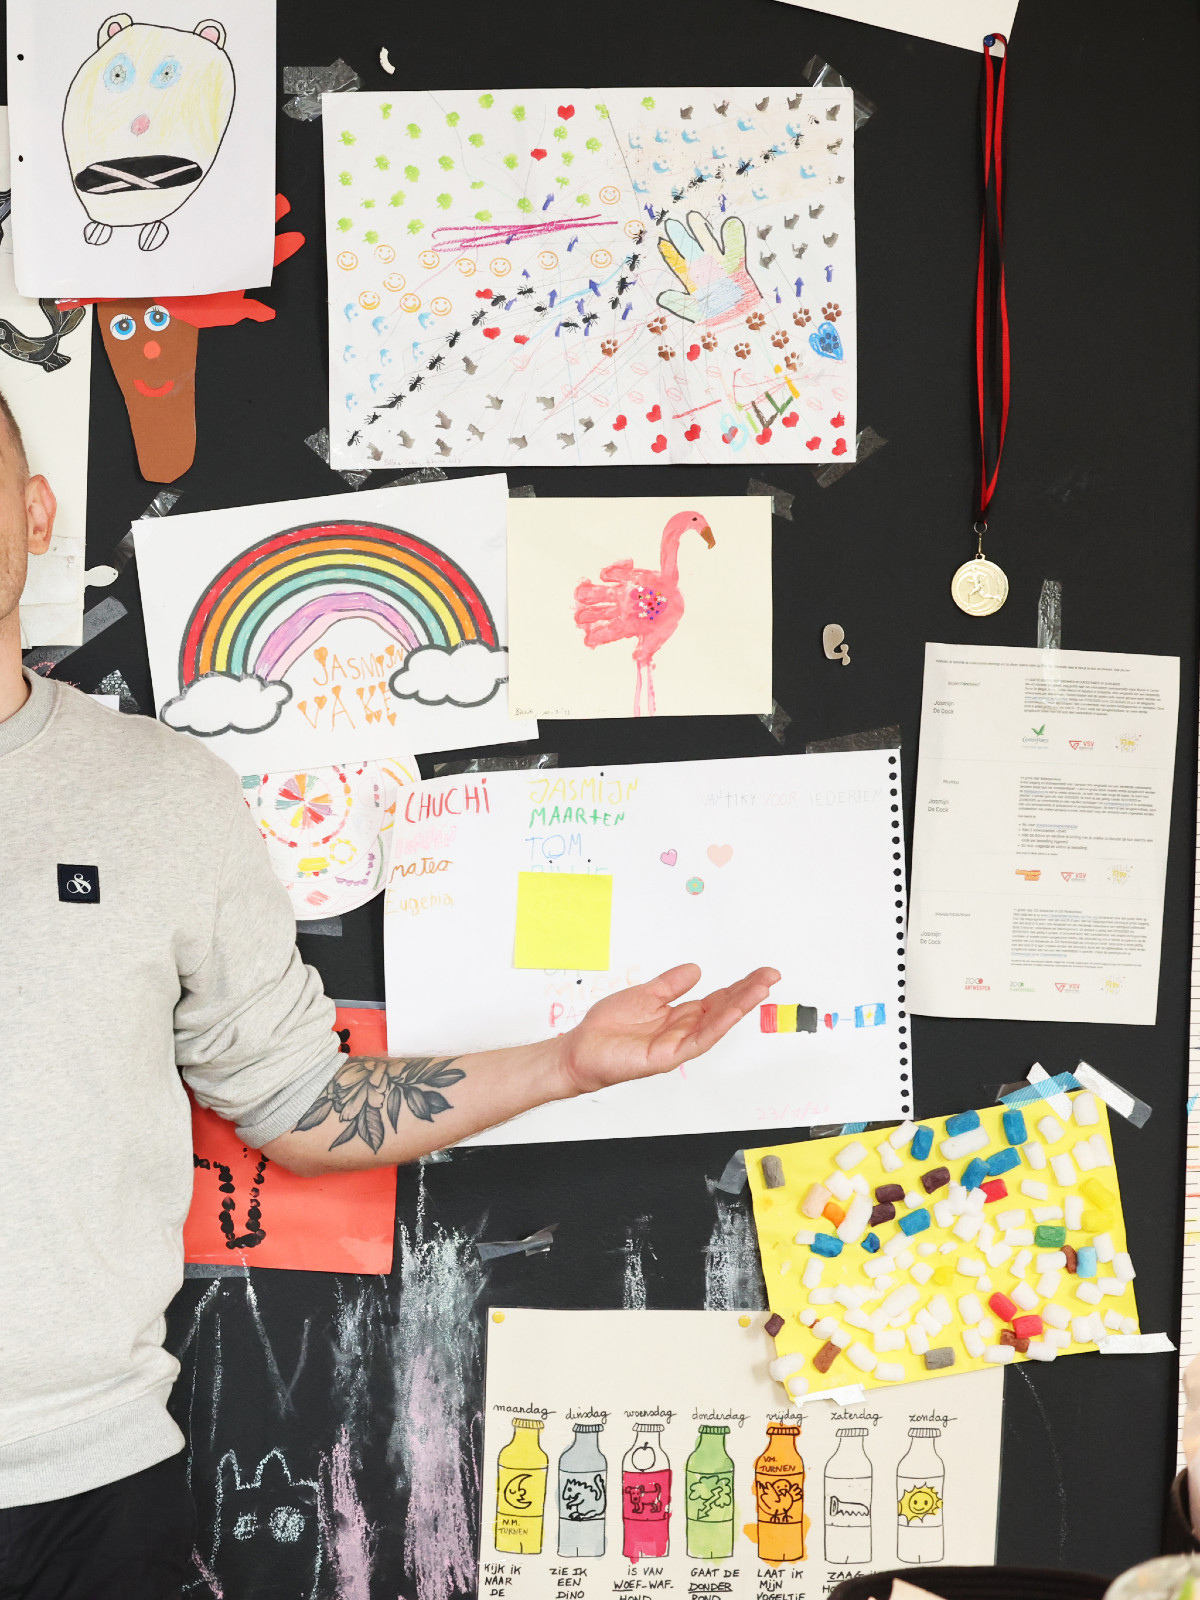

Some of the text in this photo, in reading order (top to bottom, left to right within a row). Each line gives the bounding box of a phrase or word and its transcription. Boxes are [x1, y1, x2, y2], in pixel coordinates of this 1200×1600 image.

[313, 645, 404, 687] JASMIJN
[296, 681, 398, 733] VAKE
[526, 775, 640, 806] JASMIJN
[524, 833, 584, 861] TOM
[493, 1403, 557, 1421] maandag
[565, 1406, 613, 1425] dinsdag
[624, 1405, 677, 1425] woensdag
[692, 1406, 751, 1428] donderdag
[766, 1409, 810, 1428] vrijdag
[831, 1408, 884, 1427] zaterdag
[908, 1408, 959, 1428] zondag
[759, 1464, 797, 1473] TURNEN
[571, 1567, 588, 1577] IK
[643, 1567, 664, 1576] VAN
[690, 1567, 740, 1578] GAAT DE
[757, 1568, 786, 1579] LAAT
[484, 1577, 513, 1586] NAAR
[557, 1577, 582, 1587] EEN
[688, 1582, 733, 1592] DONDER
[489, 1588, 506, 1597] DE
